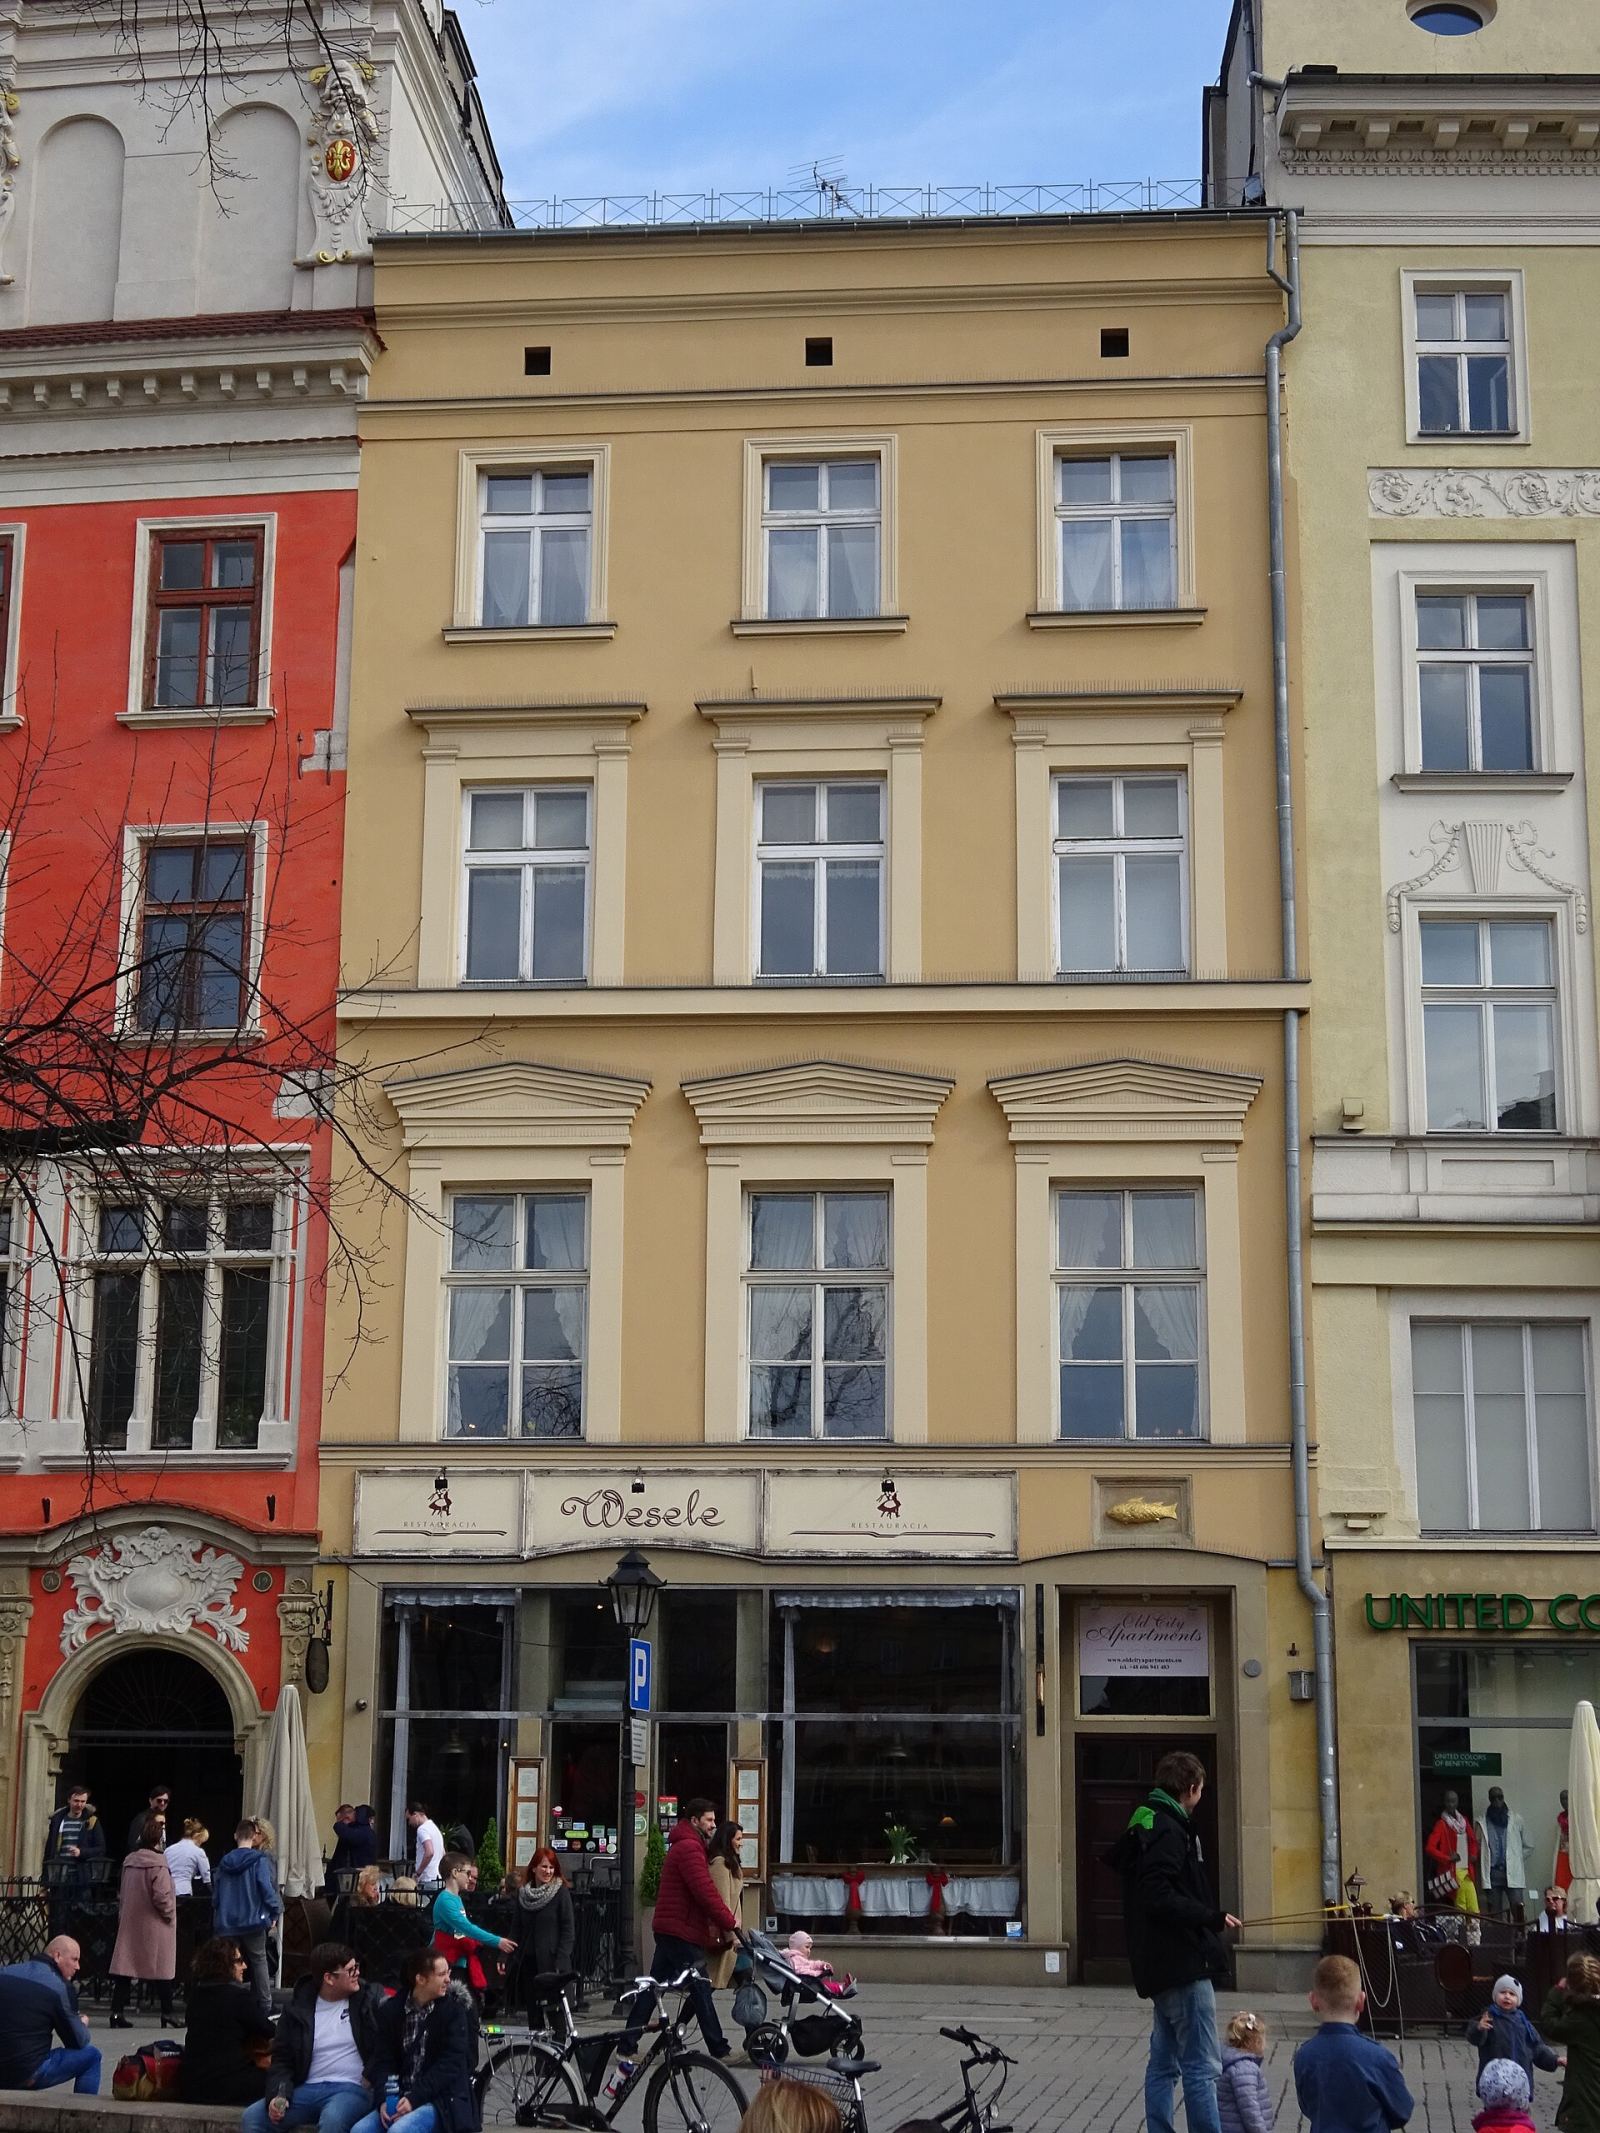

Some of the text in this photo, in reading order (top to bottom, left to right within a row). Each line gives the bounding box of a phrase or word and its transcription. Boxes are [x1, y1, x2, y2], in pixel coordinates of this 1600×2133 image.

[560, 1488, 726, 1529] Wesele
[851, 1522, 929, 1530] RESTAURACJA
[1122, 1612, 1185, 1631] Old City
[1365, 1593, 1534, 1631] UNITED
[1085, 1623, 1202, 1648] Apartments
[634, 1647, 647, 1702] P
